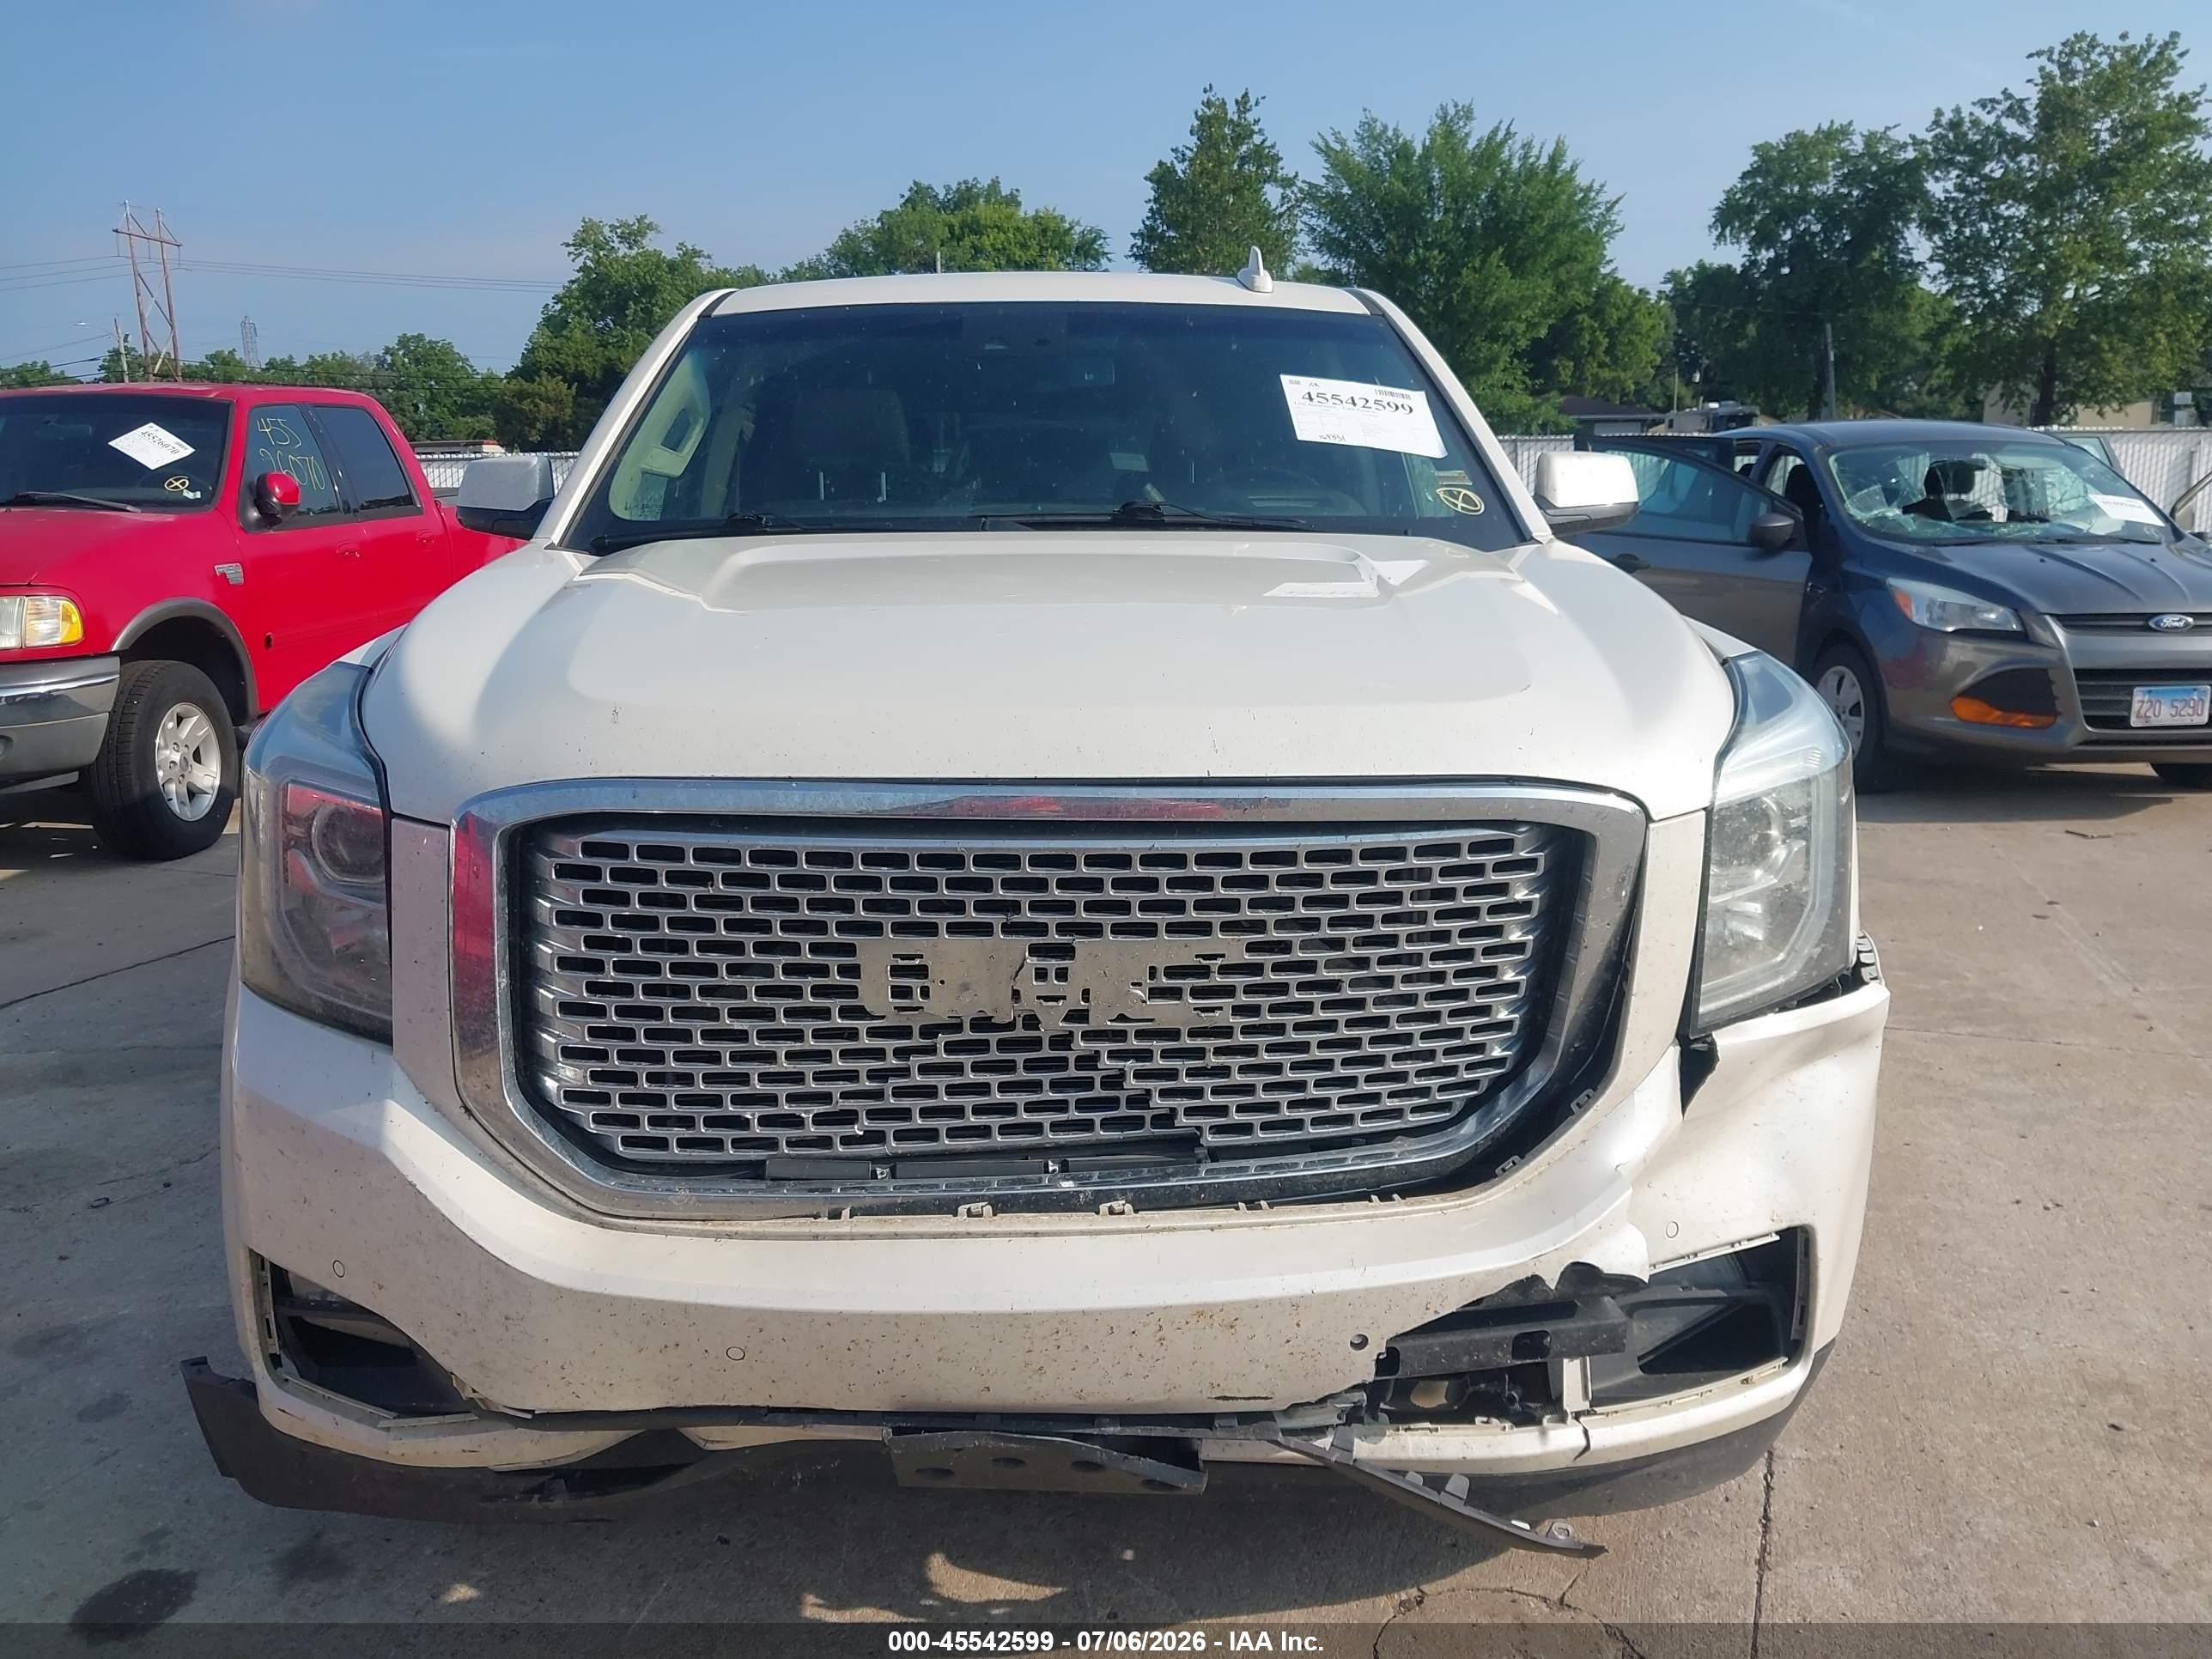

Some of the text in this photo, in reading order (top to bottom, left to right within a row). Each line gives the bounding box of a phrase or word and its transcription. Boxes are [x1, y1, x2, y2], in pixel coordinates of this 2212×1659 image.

[1301, 391, 1413, 415] 45542599
[140, 430, 179, 454] 45526070
[257, 417, 301, 448] 455
[2160, 617, 2185, 628] Ford
[2136, 697, 2205, 719] Z20 5290
